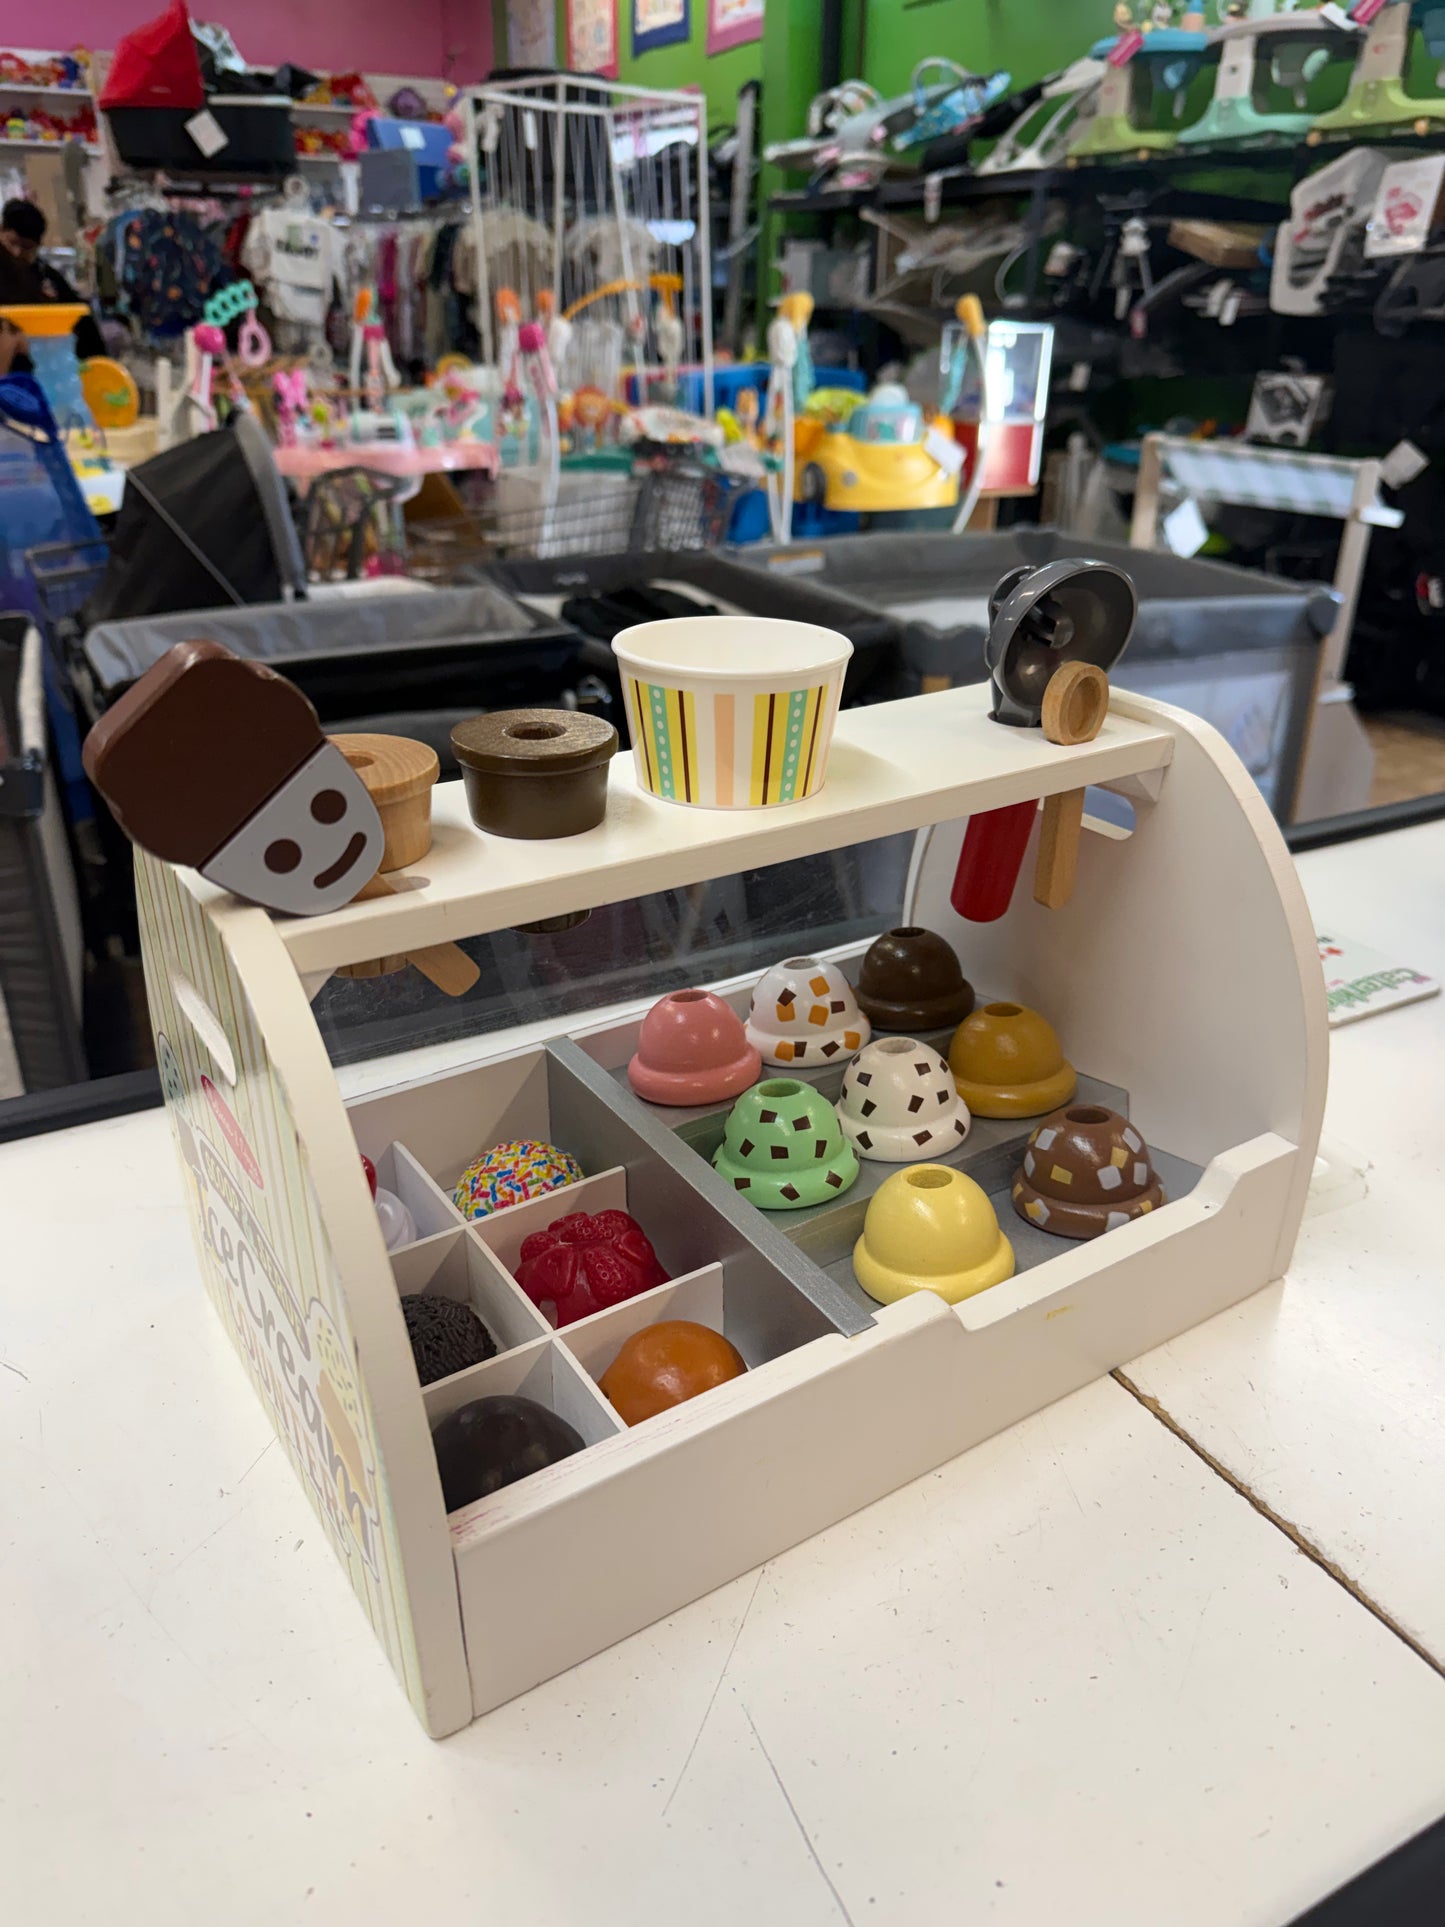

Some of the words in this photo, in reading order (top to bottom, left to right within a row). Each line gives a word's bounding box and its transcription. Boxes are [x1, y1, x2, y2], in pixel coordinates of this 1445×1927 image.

[192, 1165, 239, 1287] Ice
[237, 1240, 373, 1563] Cream
[255, 1232, 304, 1350] SERVE
